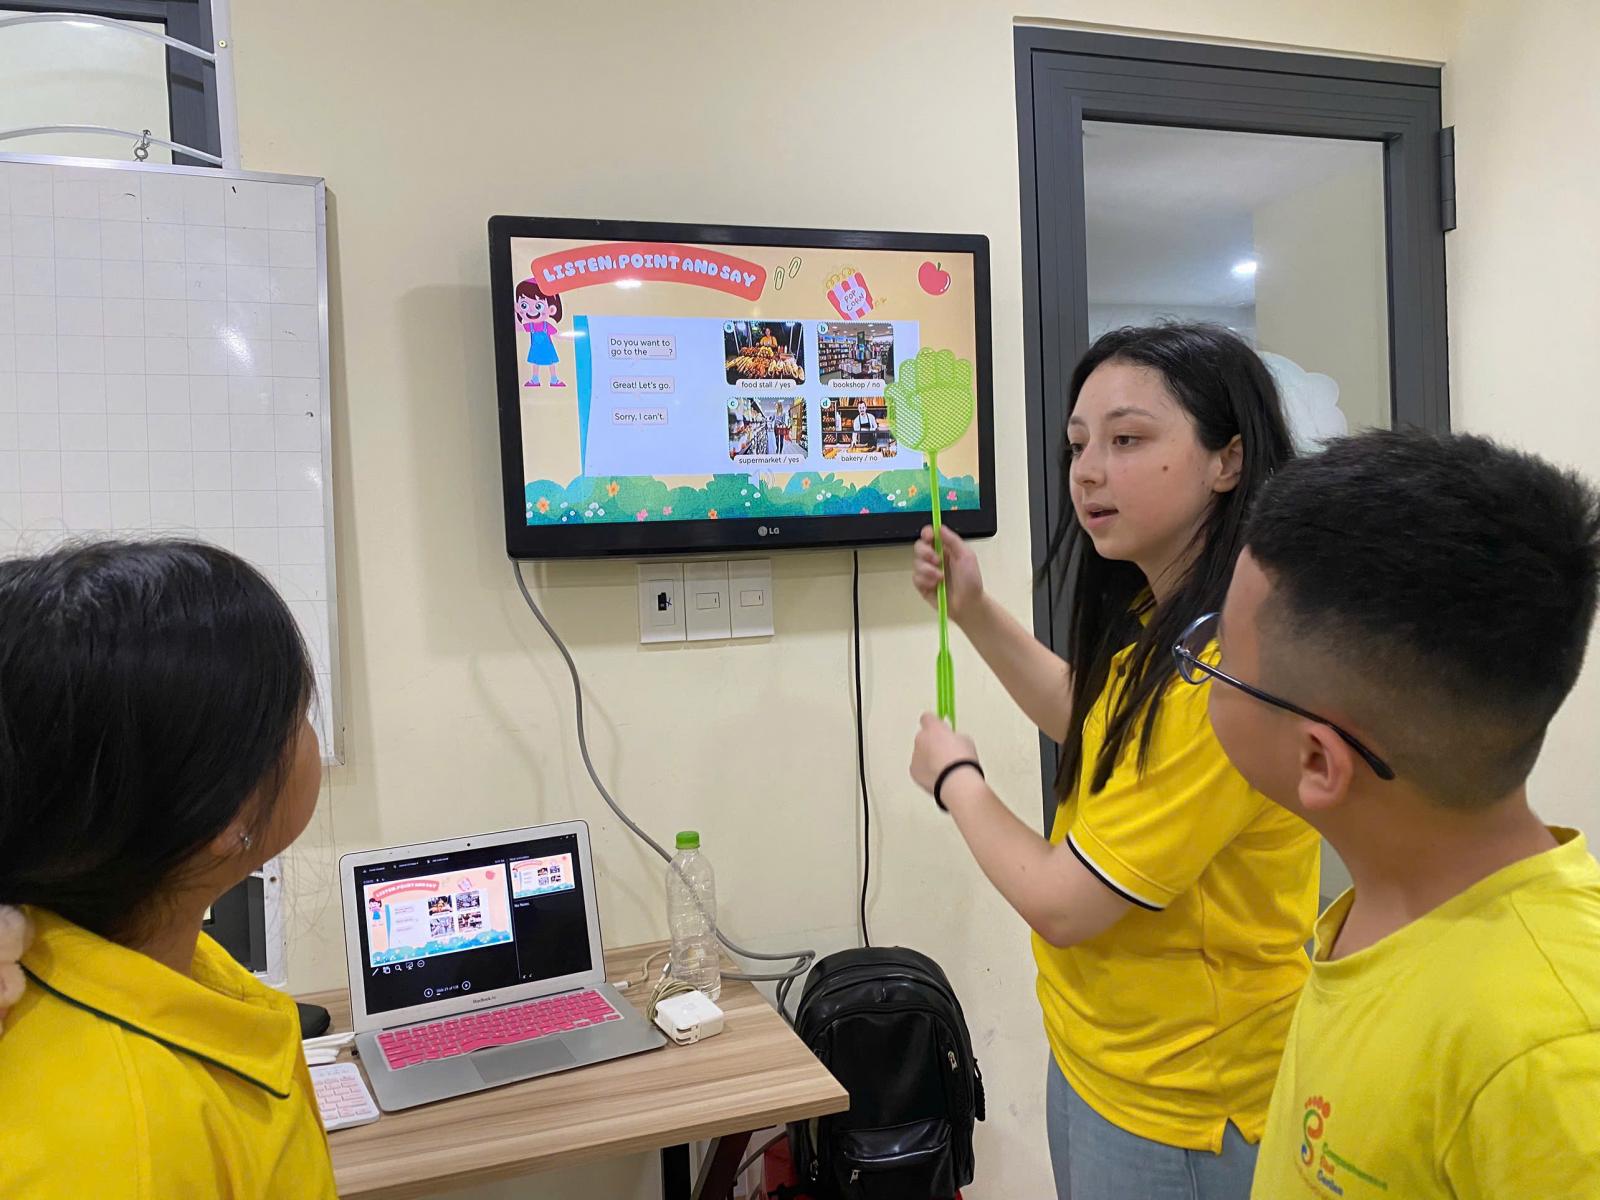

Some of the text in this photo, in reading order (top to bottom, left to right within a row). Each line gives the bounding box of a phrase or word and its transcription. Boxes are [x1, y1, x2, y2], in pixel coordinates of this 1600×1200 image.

[543, 253, 757, 288] LISTEN, POINT AND SAY
[844, 290, 856, 303] POP
[847, 293, 864, 311] CORN
[610, 338, 622, 346] Do
[611, 349, 622, 357] go
[612, 381, 637, 389] Great!
[638, 381, 656, 389] Let's
[832, 381, 865, 389] bookshop
[614, 412, 638, 422] Sorry,
[643, 412, 665, 420] can't.
[738, 456, 781, 465] supermarket
[841, 454, 863, 463] bakery
[769, 527, 780, 535] LG
